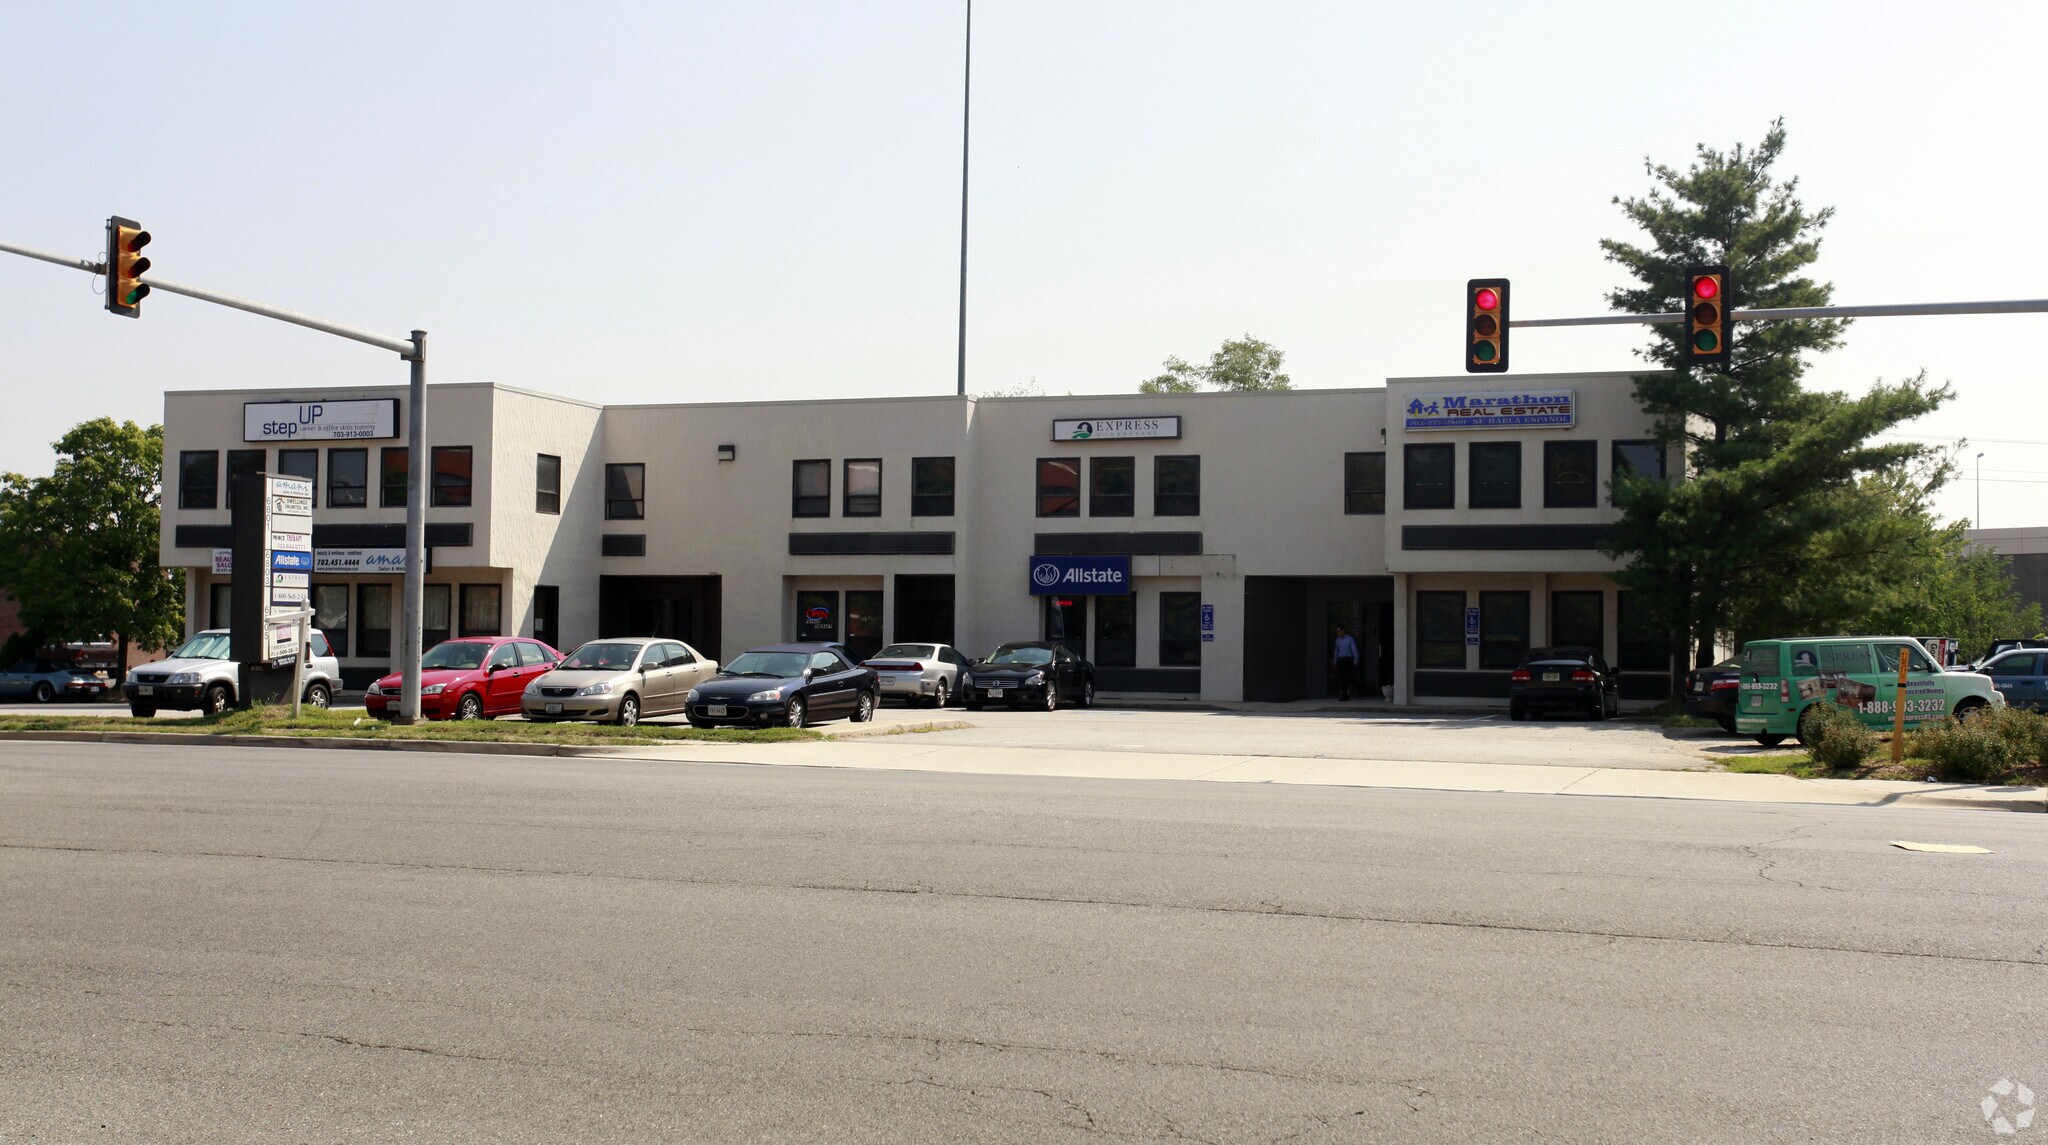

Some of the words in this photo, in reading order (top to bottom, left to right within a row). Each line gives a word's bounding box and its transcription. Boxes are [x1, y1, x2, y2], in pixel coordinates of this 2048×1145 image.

[1443, 395, 1570, 409] Marathon
[299, 405, 323, 424] UP
[1447, 408, 1495, 417] REAL
[1501, 405, 1571, 415] ESTATE
[1096, 420, 1159, 432] EXPRESS
[1488, 417, 1521, 425] HABLA
[263, 420, 297, 438] step
[275, 554, 300, 566] Allstate
[366, 555, 406, 565] ama
[1062, 567, 1122, 583] Allstate
